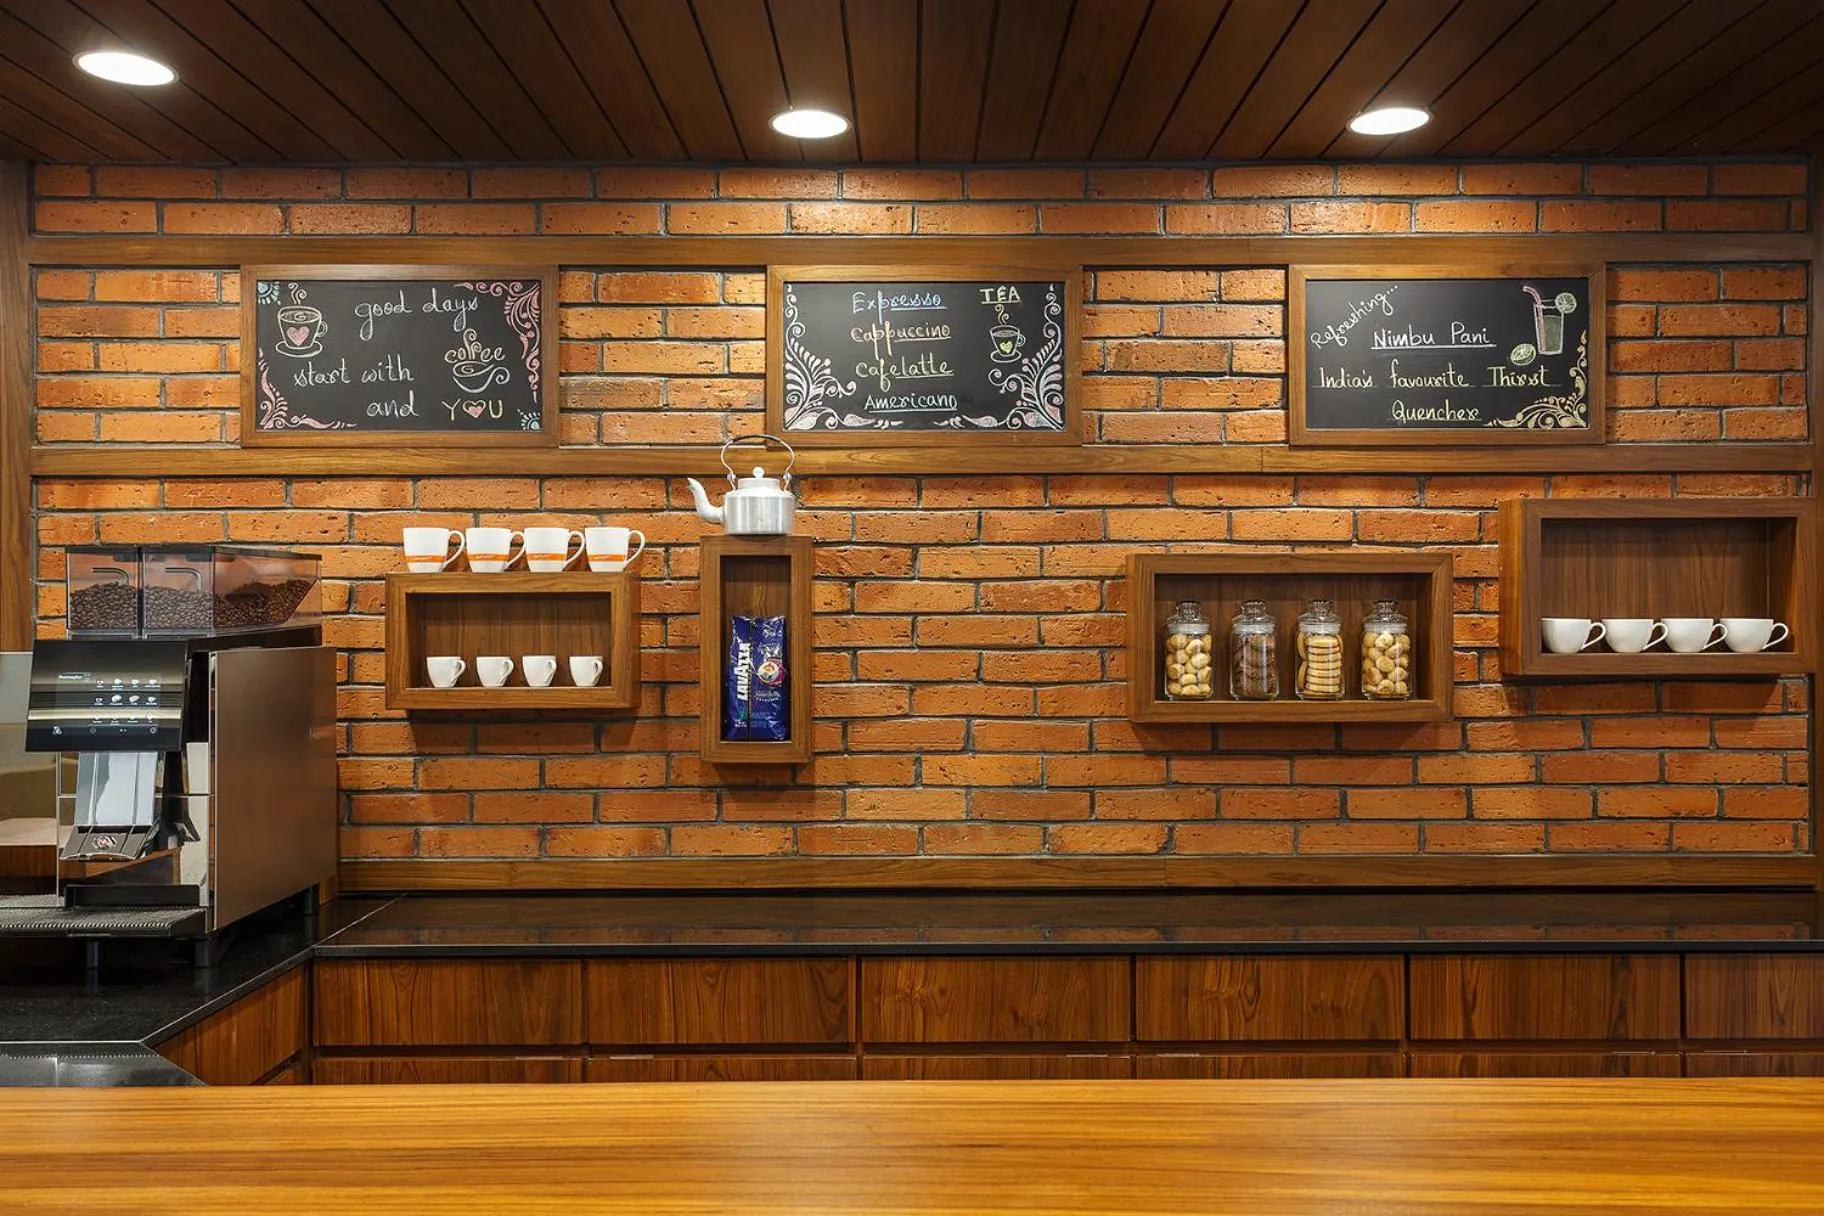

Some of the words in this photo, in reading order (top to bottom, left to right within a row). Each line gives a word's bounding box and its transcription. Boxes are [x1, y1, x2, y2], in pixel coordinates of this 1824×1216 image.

[980, 285, 1021, 302] TEA
[354, 290, 412, 341] good
[422, 288, 478, 332] days
[850, 320, 951, 361] Cappuccino
[1372, 323, 1436, 347] Nimbu
[1451, 321, 1490, 345] Pani
[293, 357, 351, 387] start
[361, 354, 414, 383] with
[1319, 366, 1373, 389] India's
[1388, 358, 1470, 388] favourite
[1487, 365, 1551, 388] Thirst
[366, 390, 418, 417] and
[864, 393, 958, 411] Americano
[1392, 399, 1480, 424] Quencher
[734, 642, 751, 700] LAVAZZA
